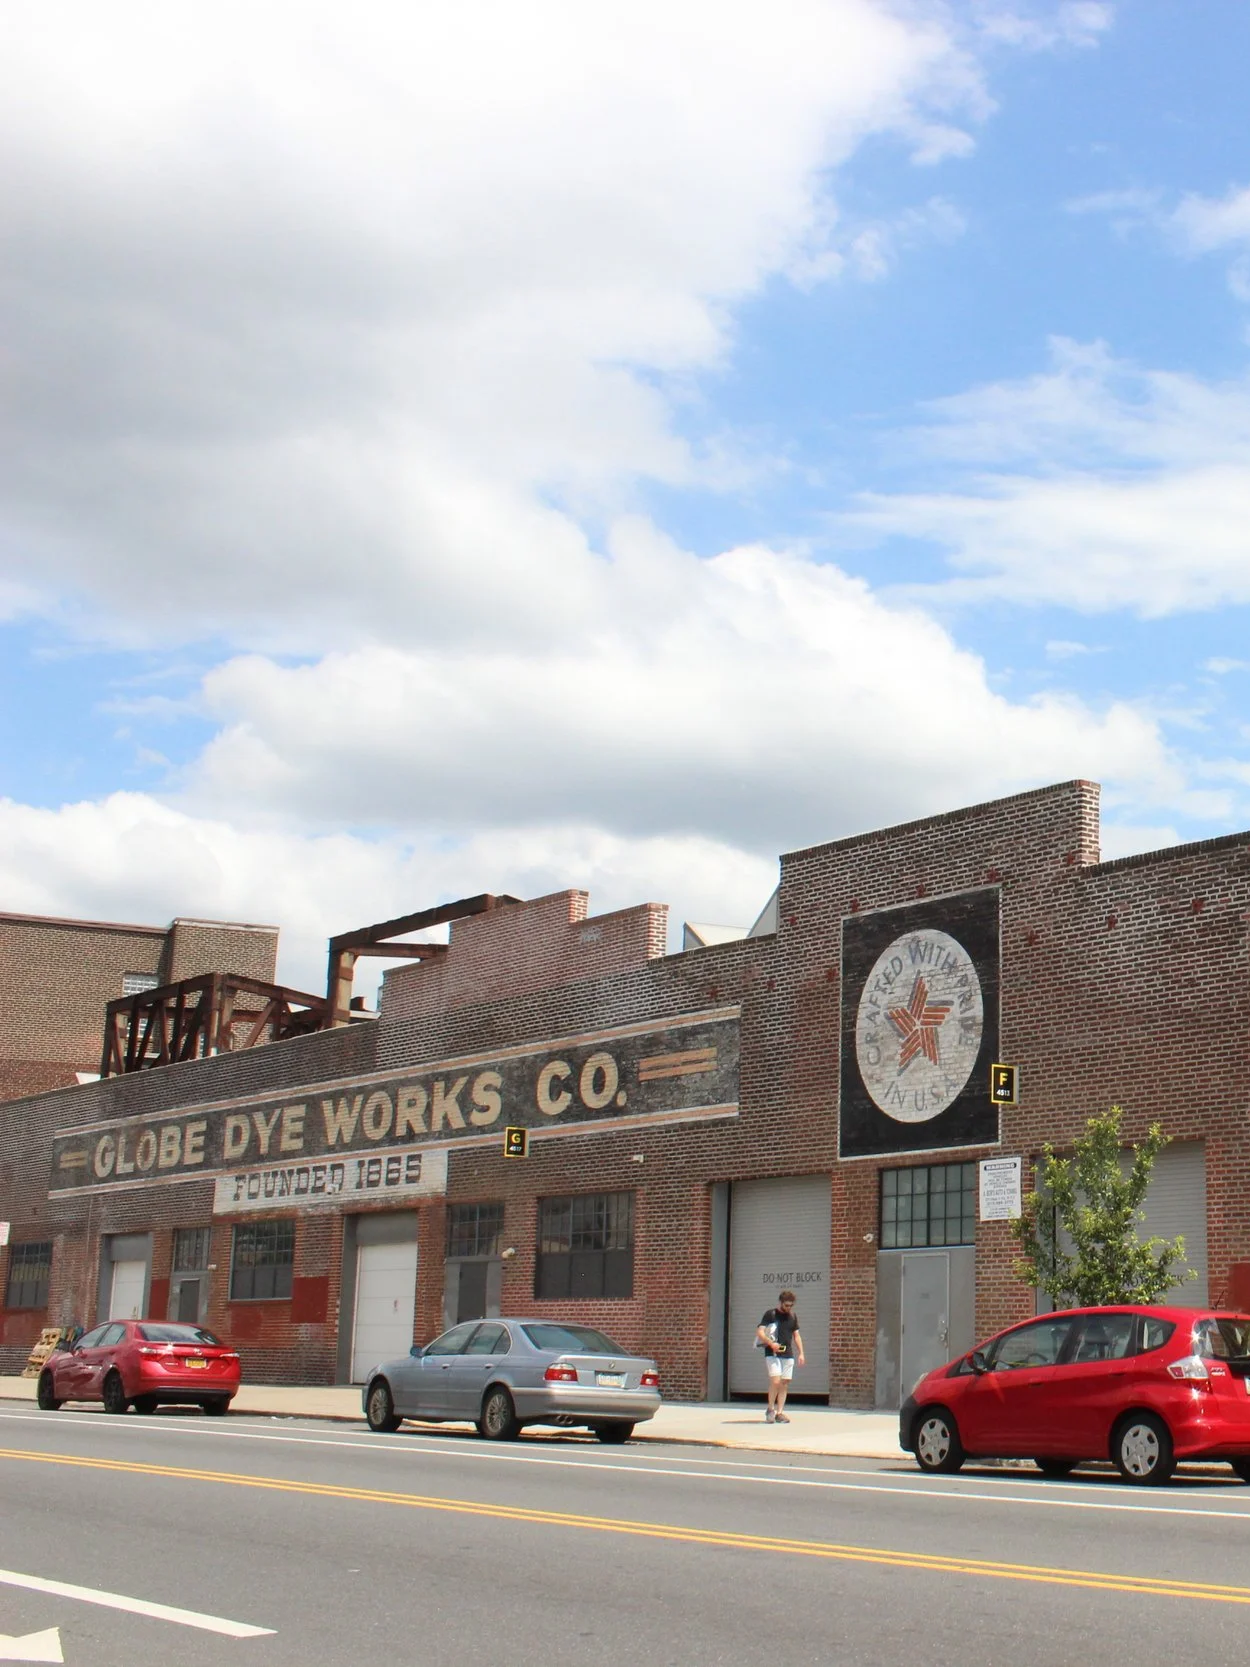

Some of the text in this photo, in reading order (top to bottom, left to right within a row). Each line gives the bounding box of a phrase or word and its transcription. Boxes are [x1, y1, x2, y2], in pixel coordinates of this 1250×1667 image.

[865, 955, 904, 1067] CRAFTED
[907, 938, 960, 976] WITH
[1000, 1072, 1008, 1086] F
[883, 1080, 906, 1109] IN
[94, 1051, 628, 1178] GLOBE DYE WORKS CO.
[511, 1133, 521, 1144] G
[232, 1153, 423, 1202] FOUNDED 1865
[763, 1271, 822, 1284] DO NOT BLOCK
